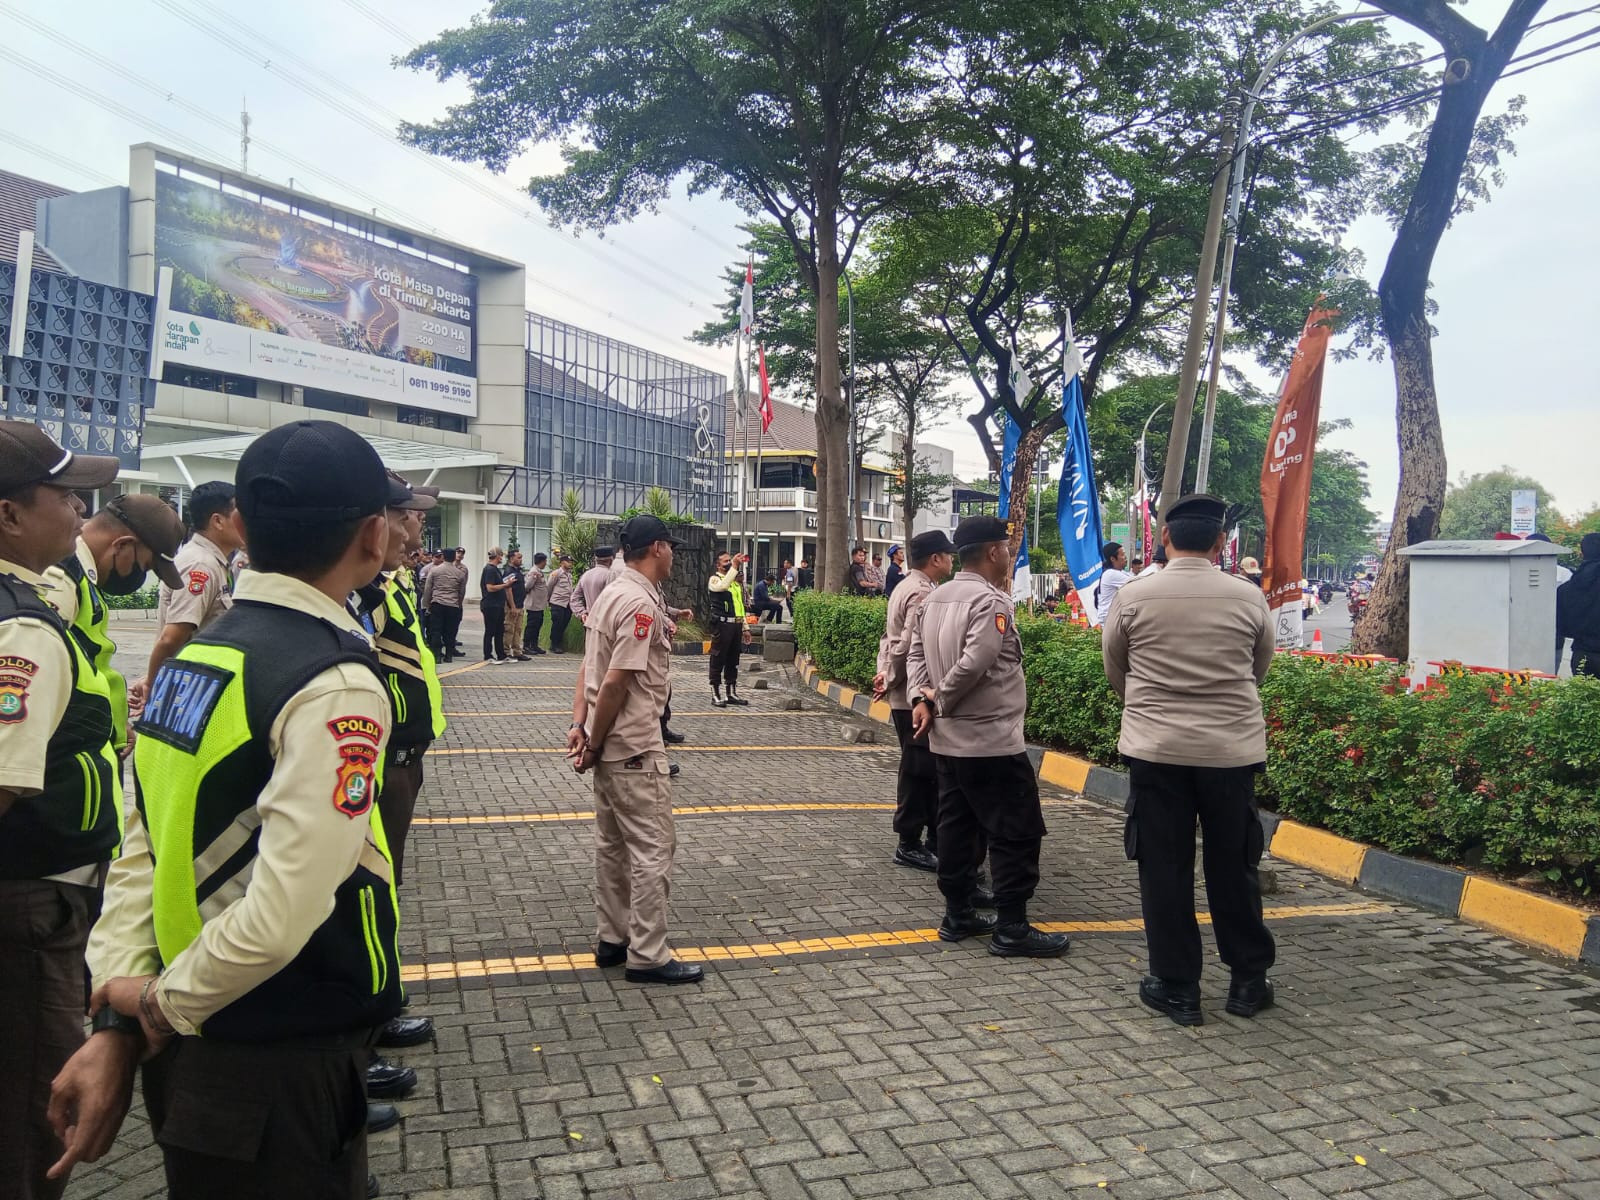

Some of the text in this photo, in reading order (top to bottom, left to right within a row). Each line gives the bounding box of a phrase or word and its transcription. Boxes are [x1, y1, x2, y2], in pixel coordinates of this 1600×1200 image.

[374, 266, 471, 307] Kota Masa Depan
[379, 284, 471, 321] di Timur Jakarta
[422, 320, 465, 342] 2200 HA
[409, 377, 471, 398] 0811 1999 9190
[336, 719, 379, 738] POLDA
